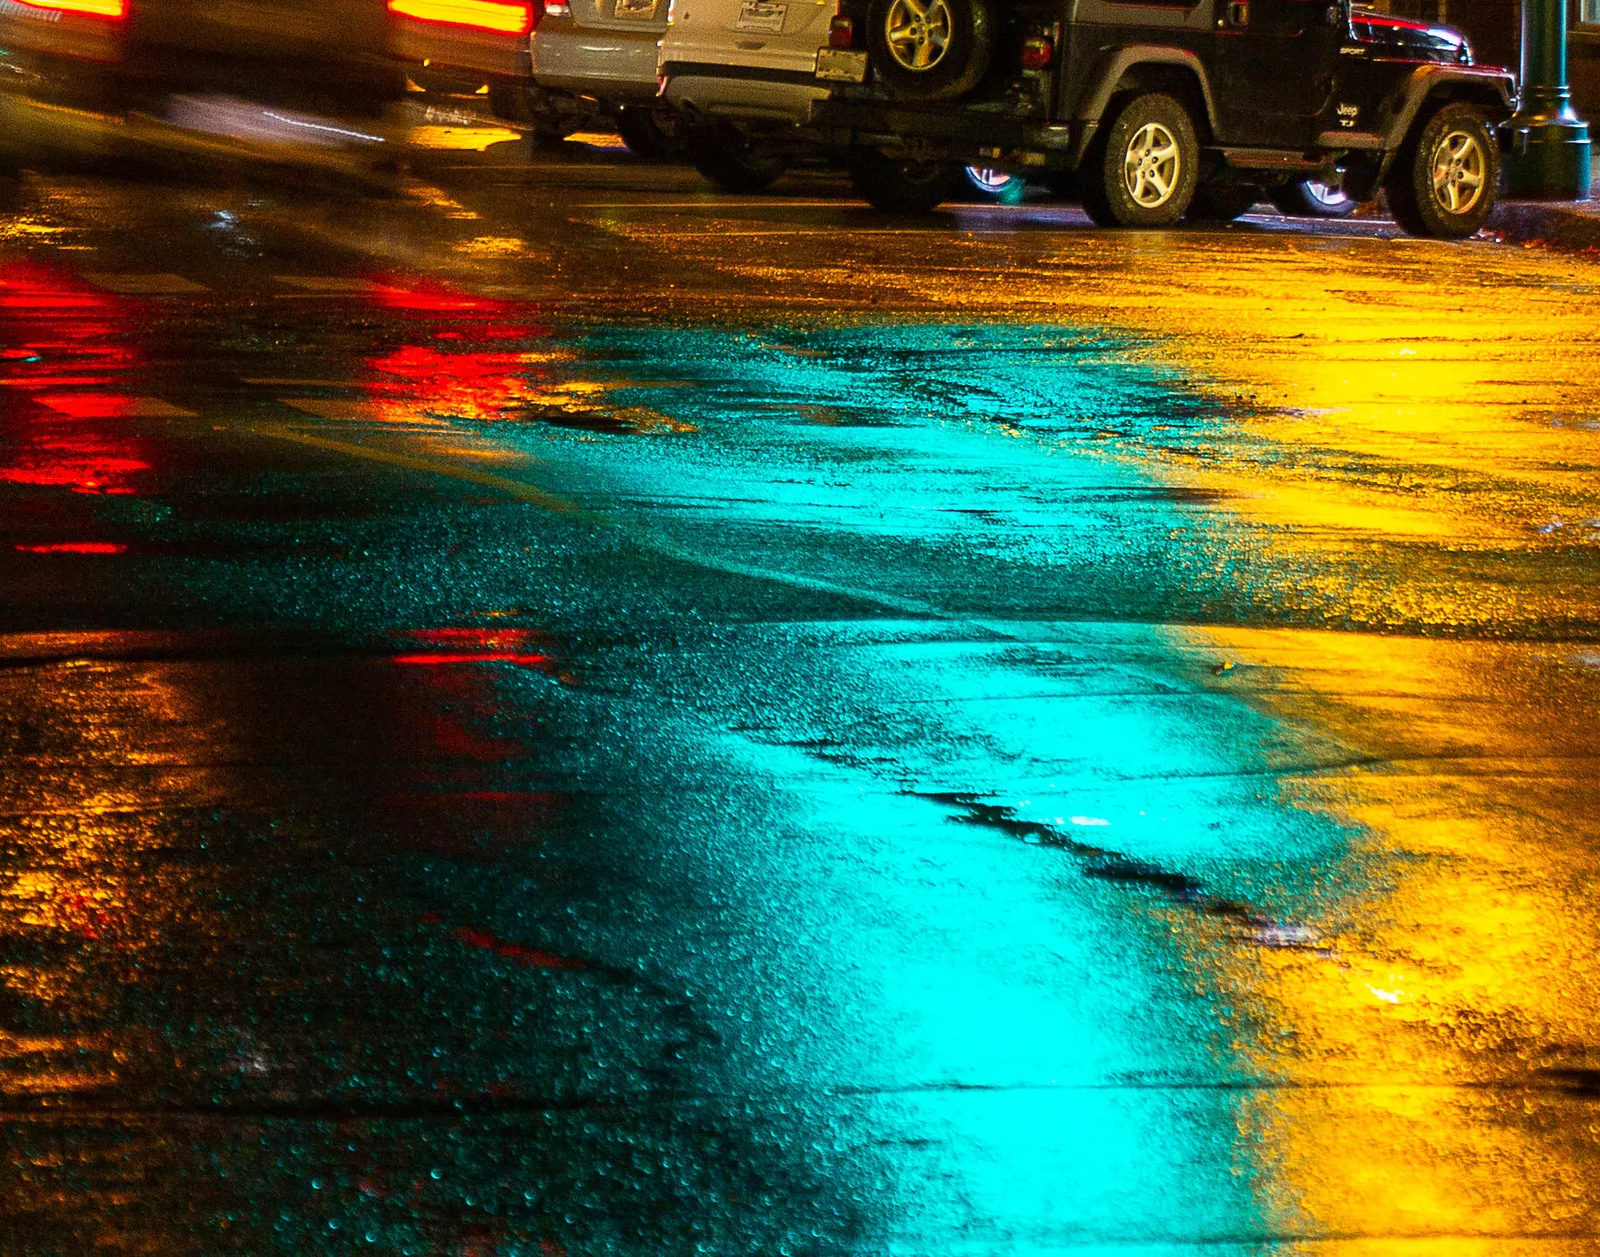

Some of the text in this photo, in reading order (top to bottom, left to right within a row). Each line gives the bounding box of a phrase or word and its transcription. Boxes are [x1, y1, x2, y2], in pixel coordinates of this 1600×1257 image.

[1340, 47, 1366, 55] SPORT
[1336, 104, 1359, 117] Jeep
[1340, 119, 1355, 127] TJ
